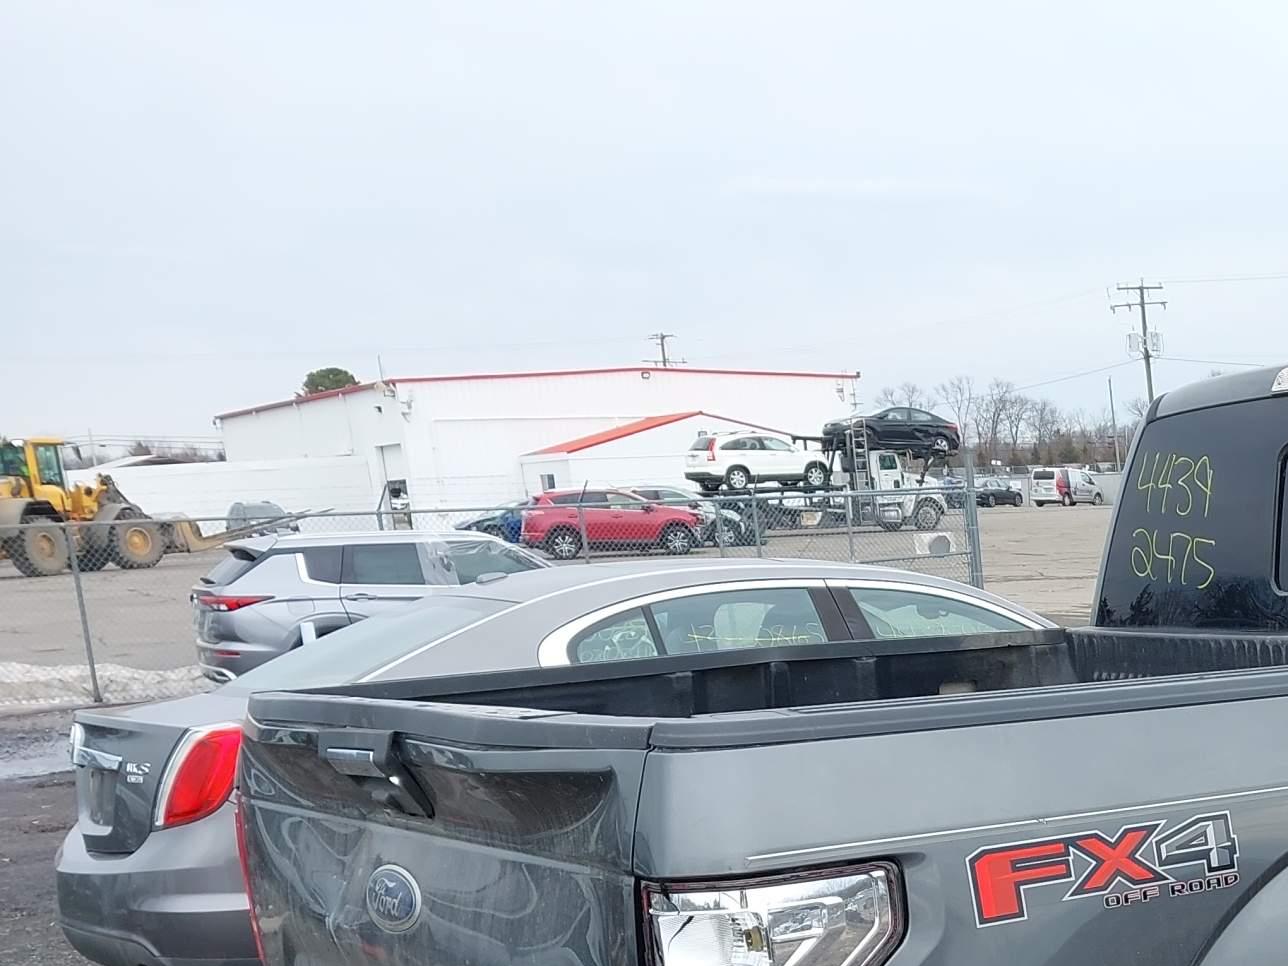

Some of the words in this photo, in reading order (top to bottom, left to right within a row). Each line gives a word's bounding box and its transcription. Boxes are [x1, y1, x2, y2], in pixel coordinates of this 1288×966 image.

[1137, 452, 1214, 518] 4439
[1131, 529, 1216, 589] 2475
[964, 810, 1240, 929] FX4
[1103, 886, 1160, 909] OFF
[1169, 872, 1240, 897] ROAD
